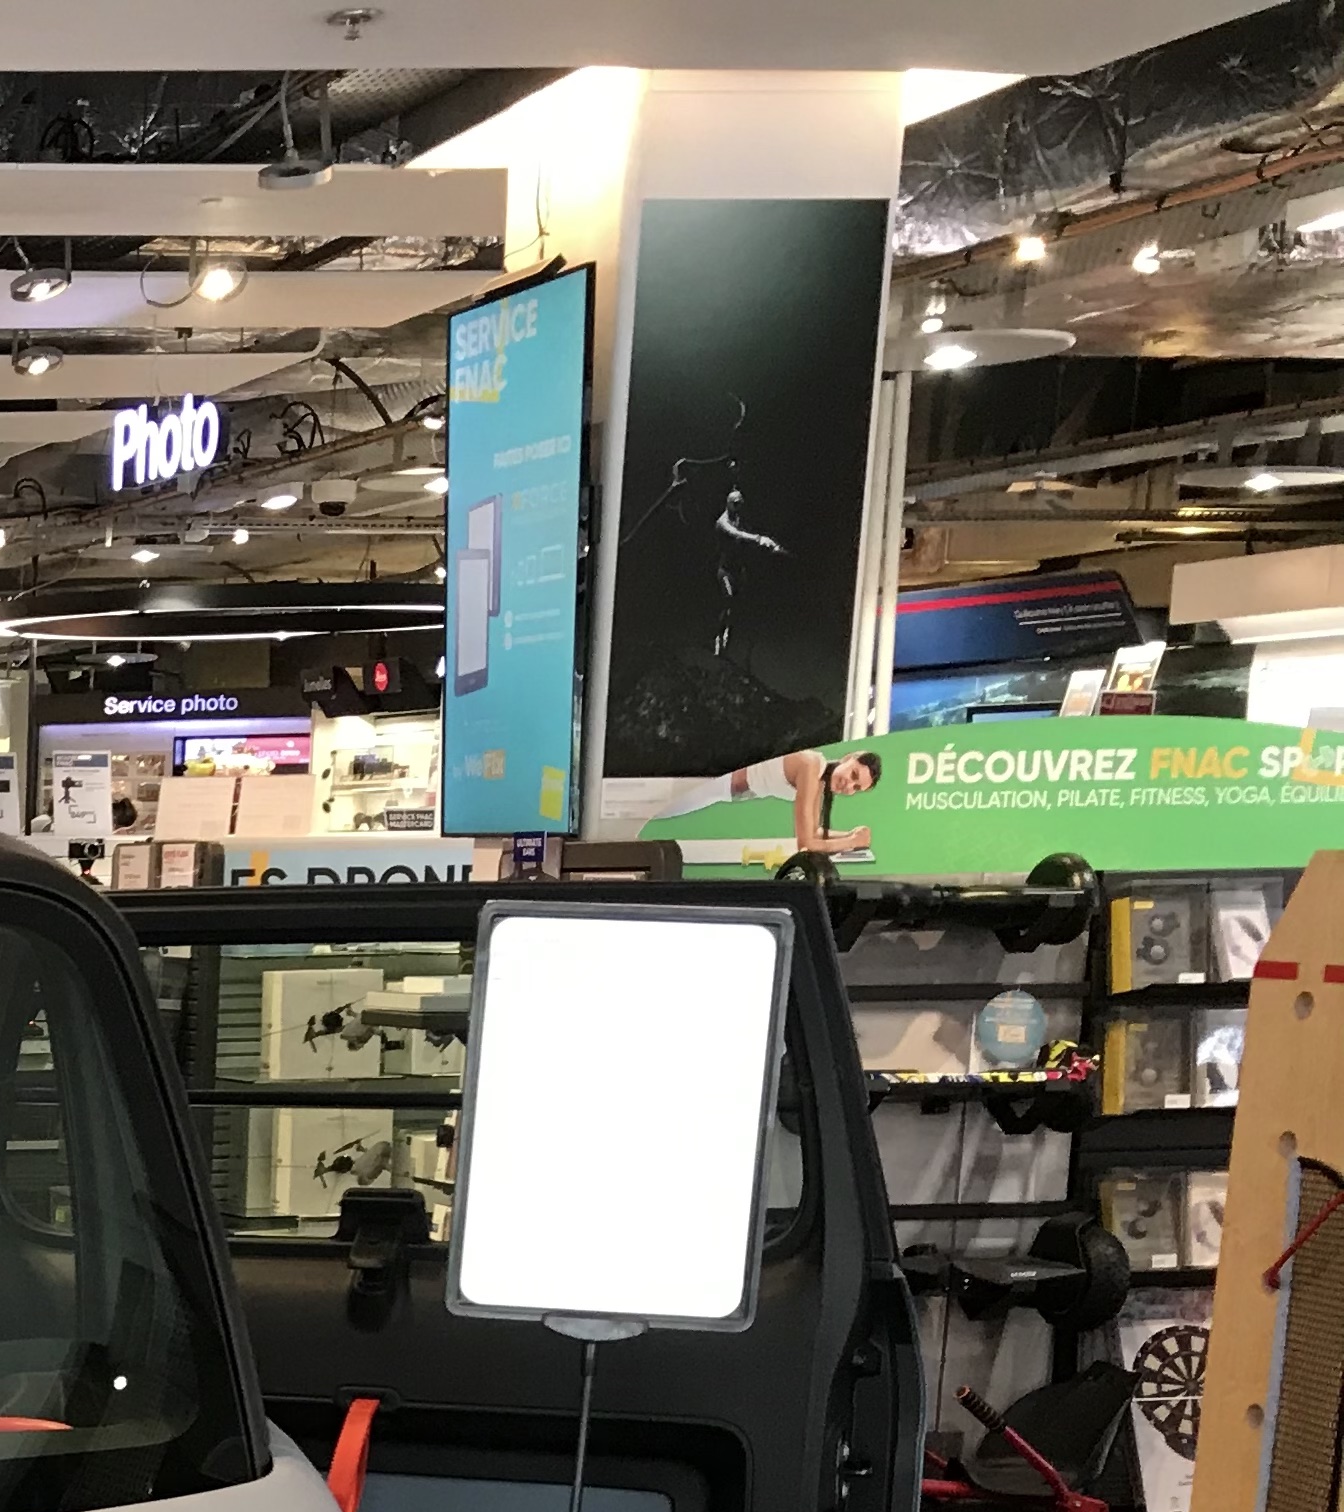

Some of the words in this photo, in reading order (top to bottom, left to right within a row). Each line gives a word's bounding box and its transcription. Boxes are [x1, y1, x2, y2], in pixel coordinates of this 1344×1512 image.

[455, 299, 538, 361] SERVICE
[455, 353, 508, 404] FNAC
[113, 393, 219, 491] Photo
[104, 695, 176, 715] Service
[180, 693, 238, 715] photo
[907, 744, 1138, 785] DÉCOUVREZ
[1149, 746, 1250, 780] FNAC
[1257, 745, 1344, 778] SP
[906, 790, 1052, 812] MUSCULATION,
[1056, 789, 1125, 809] PILATE,
[1130, 787, 1210, 808] FITNESS,
[1215, 786, 1276, 807] YOGA,
